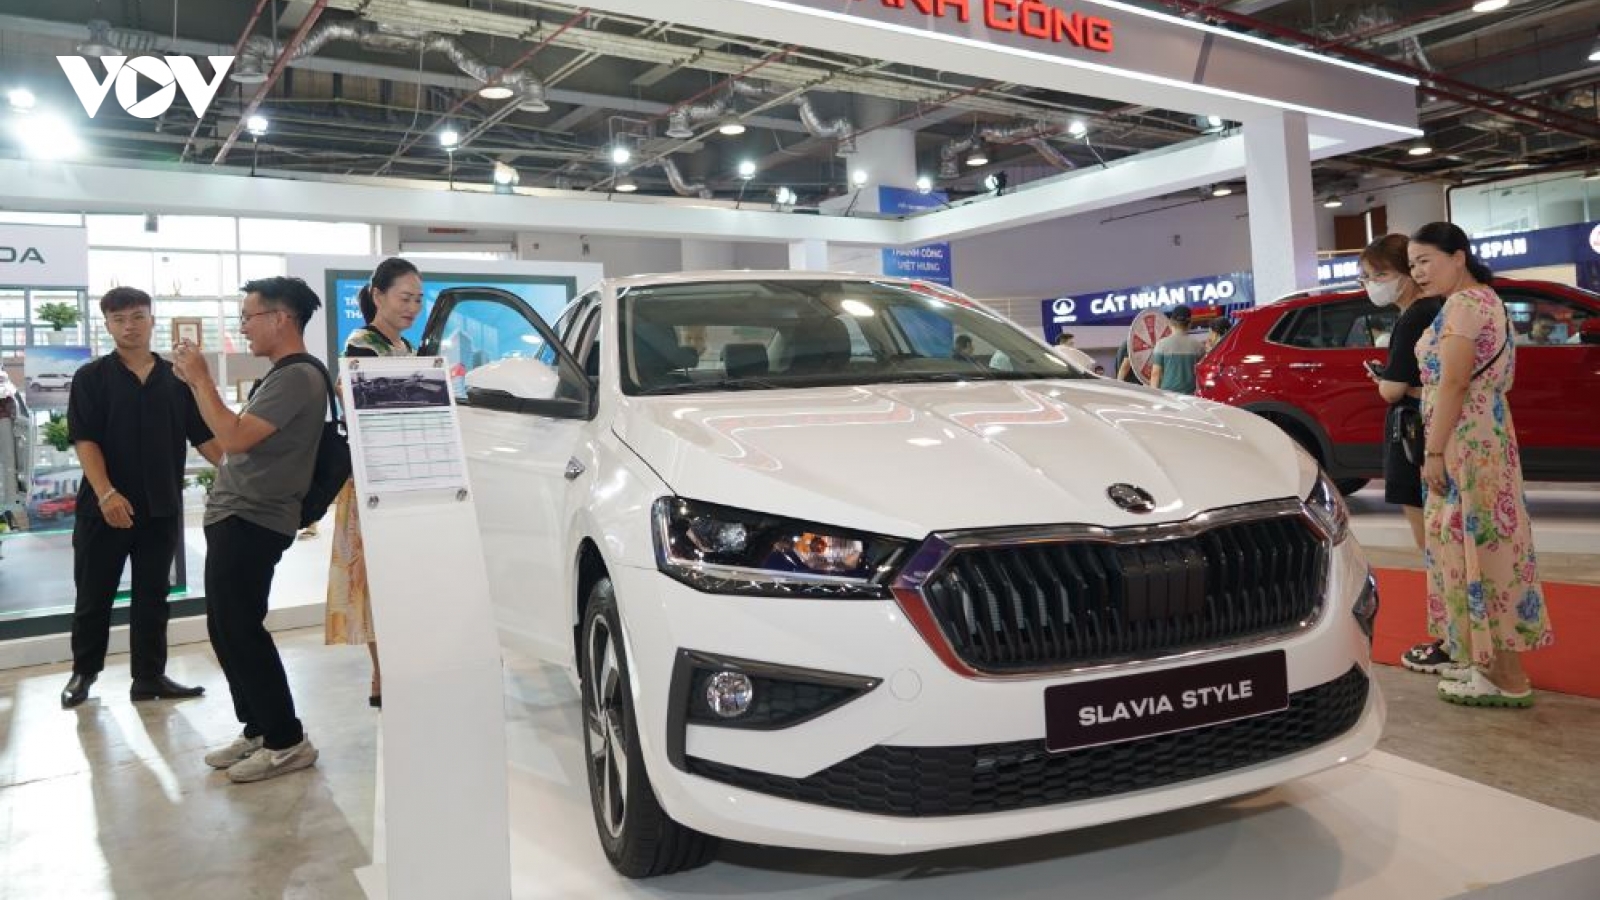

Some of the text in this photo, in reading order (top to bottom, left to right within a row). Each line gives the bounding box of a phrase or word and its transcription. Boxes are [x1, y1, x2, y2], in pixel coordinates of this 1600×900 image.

[1090, 280, 1234, 314] CÁT NHÂN TẠO
[1078, 679, 1253, 726] SLAVIA STYLE
